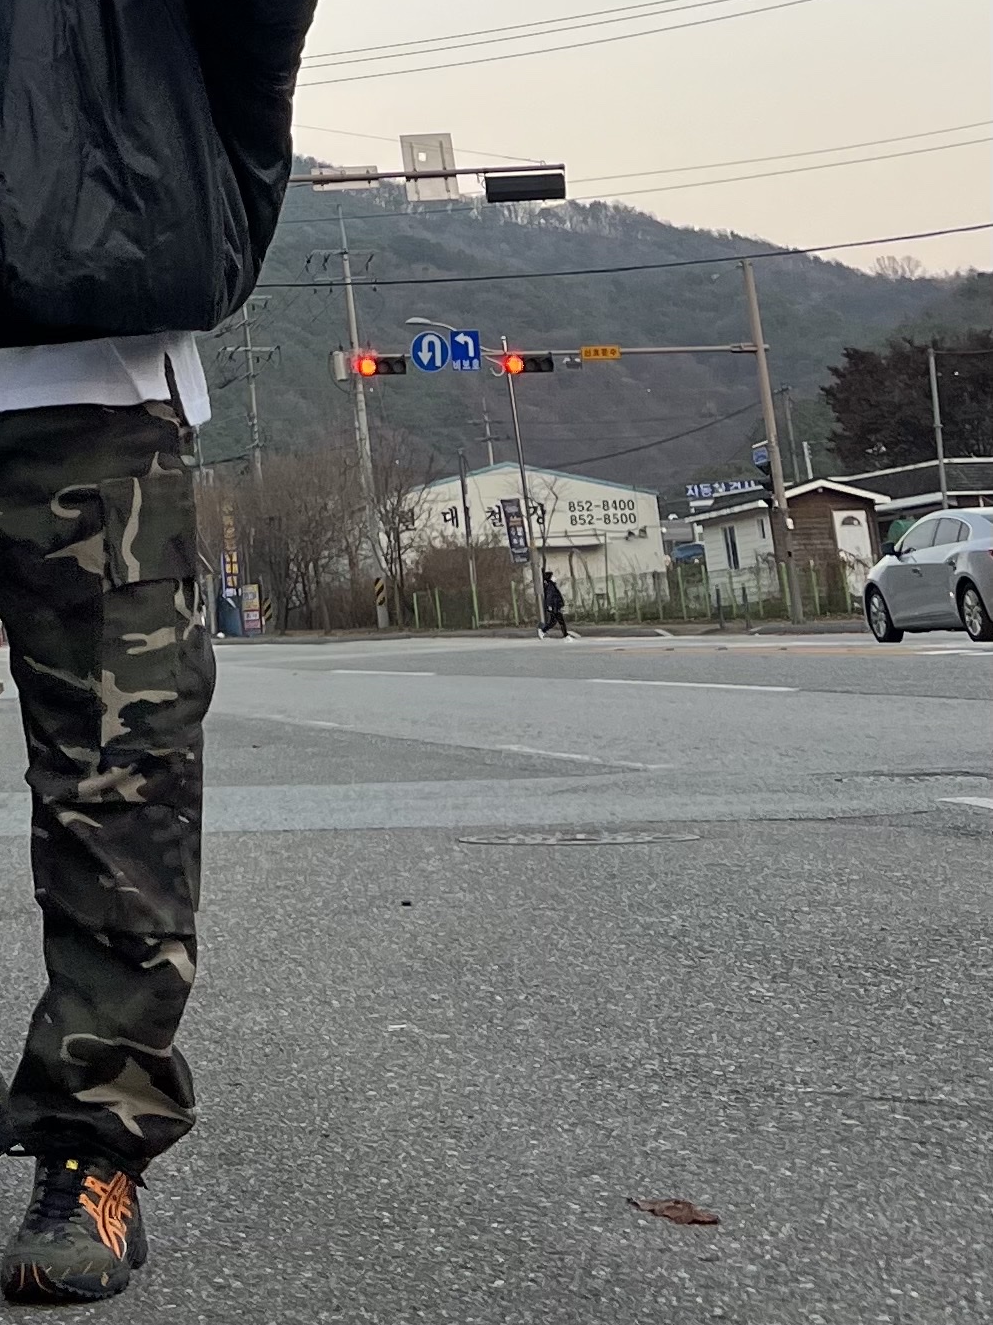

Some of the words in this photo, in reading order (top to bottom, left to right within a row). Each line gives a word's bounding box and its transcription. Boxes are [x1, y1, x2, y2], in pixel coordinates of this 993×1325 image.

[452, 358, 480, 371] 비보호
[568, 499, 635, 513] 852-8400
[570, 513, 637, 526] 852-8500
